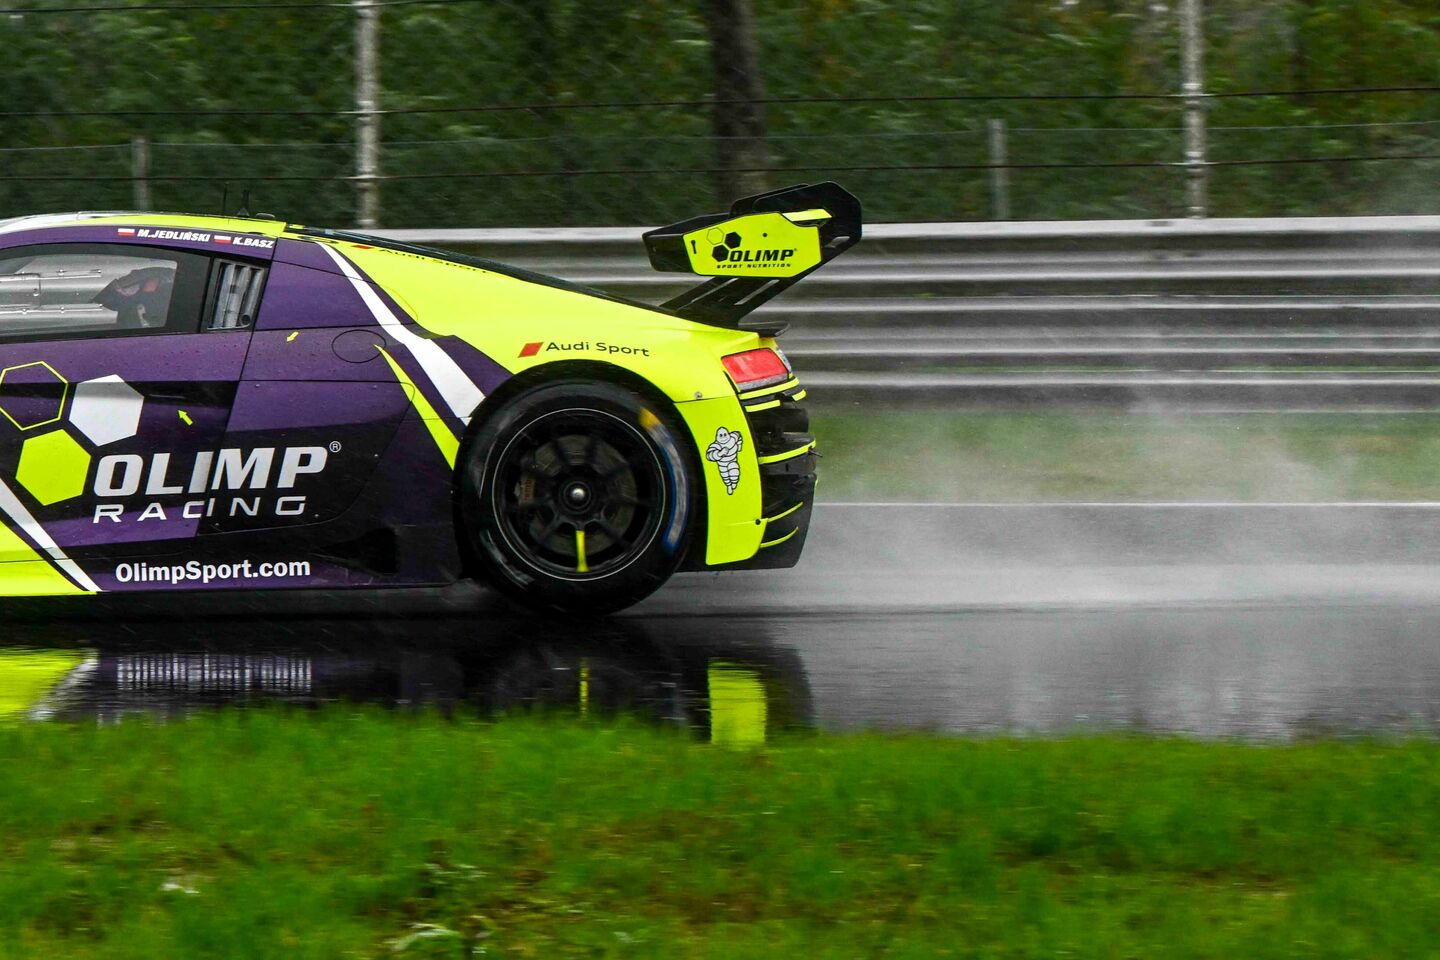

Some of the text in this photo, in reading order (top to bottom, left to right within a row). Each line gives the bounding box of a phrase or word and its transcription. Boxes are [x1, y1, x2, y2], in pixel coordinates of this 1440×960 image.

[232, 236, 275, 249] K.BASZ
[546, 341, 650, 357] Audi Sport
[93, 496, 307, 524] RACING
[115, 559, 311, 584] OlimpSport.com
